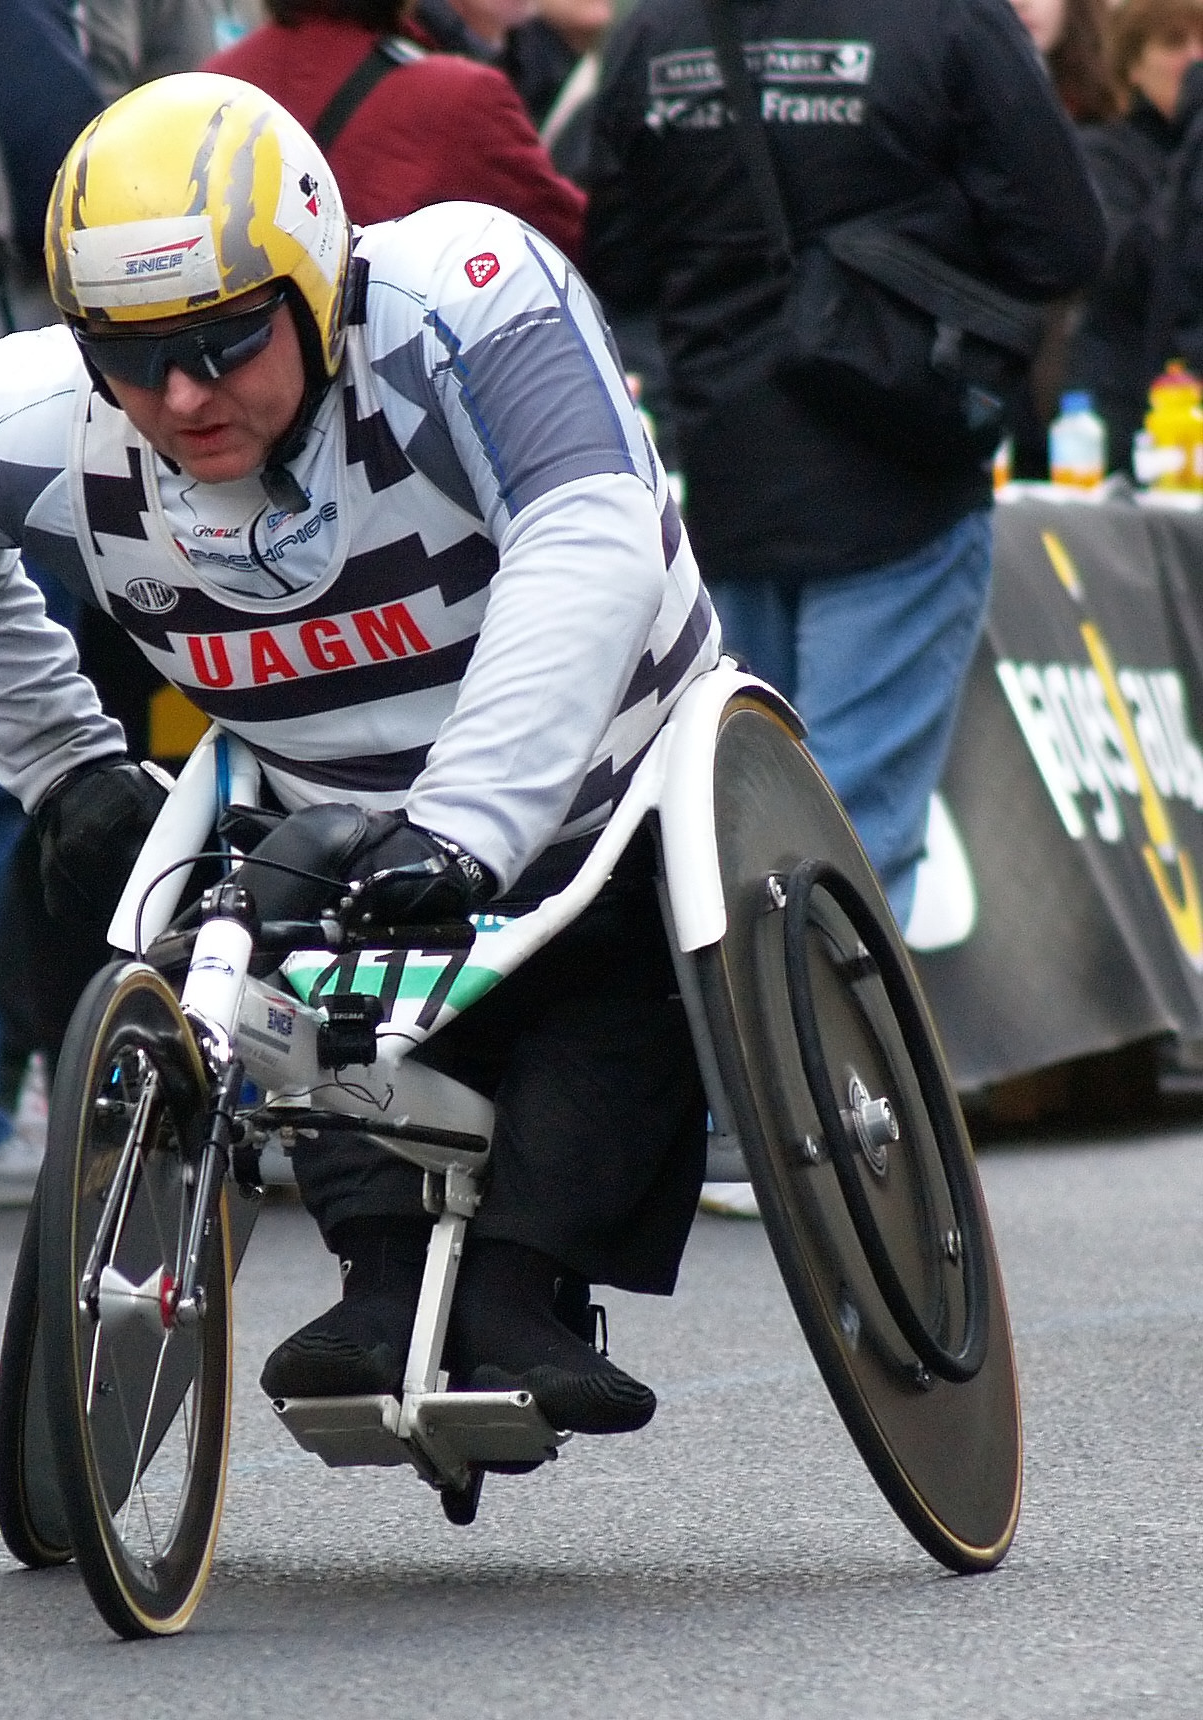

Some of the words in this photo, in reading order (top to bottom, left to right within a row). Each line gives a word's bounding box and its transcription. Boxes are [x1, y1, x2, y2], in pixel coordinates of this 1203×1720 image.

[766, 53, 823, 71] PARIS
[762, 90, 865, 124] France
[124, 252, 184, 276] SNCF
[186, 601, 433, 690] UAGM
[307, 948, 471, 1031] 417
